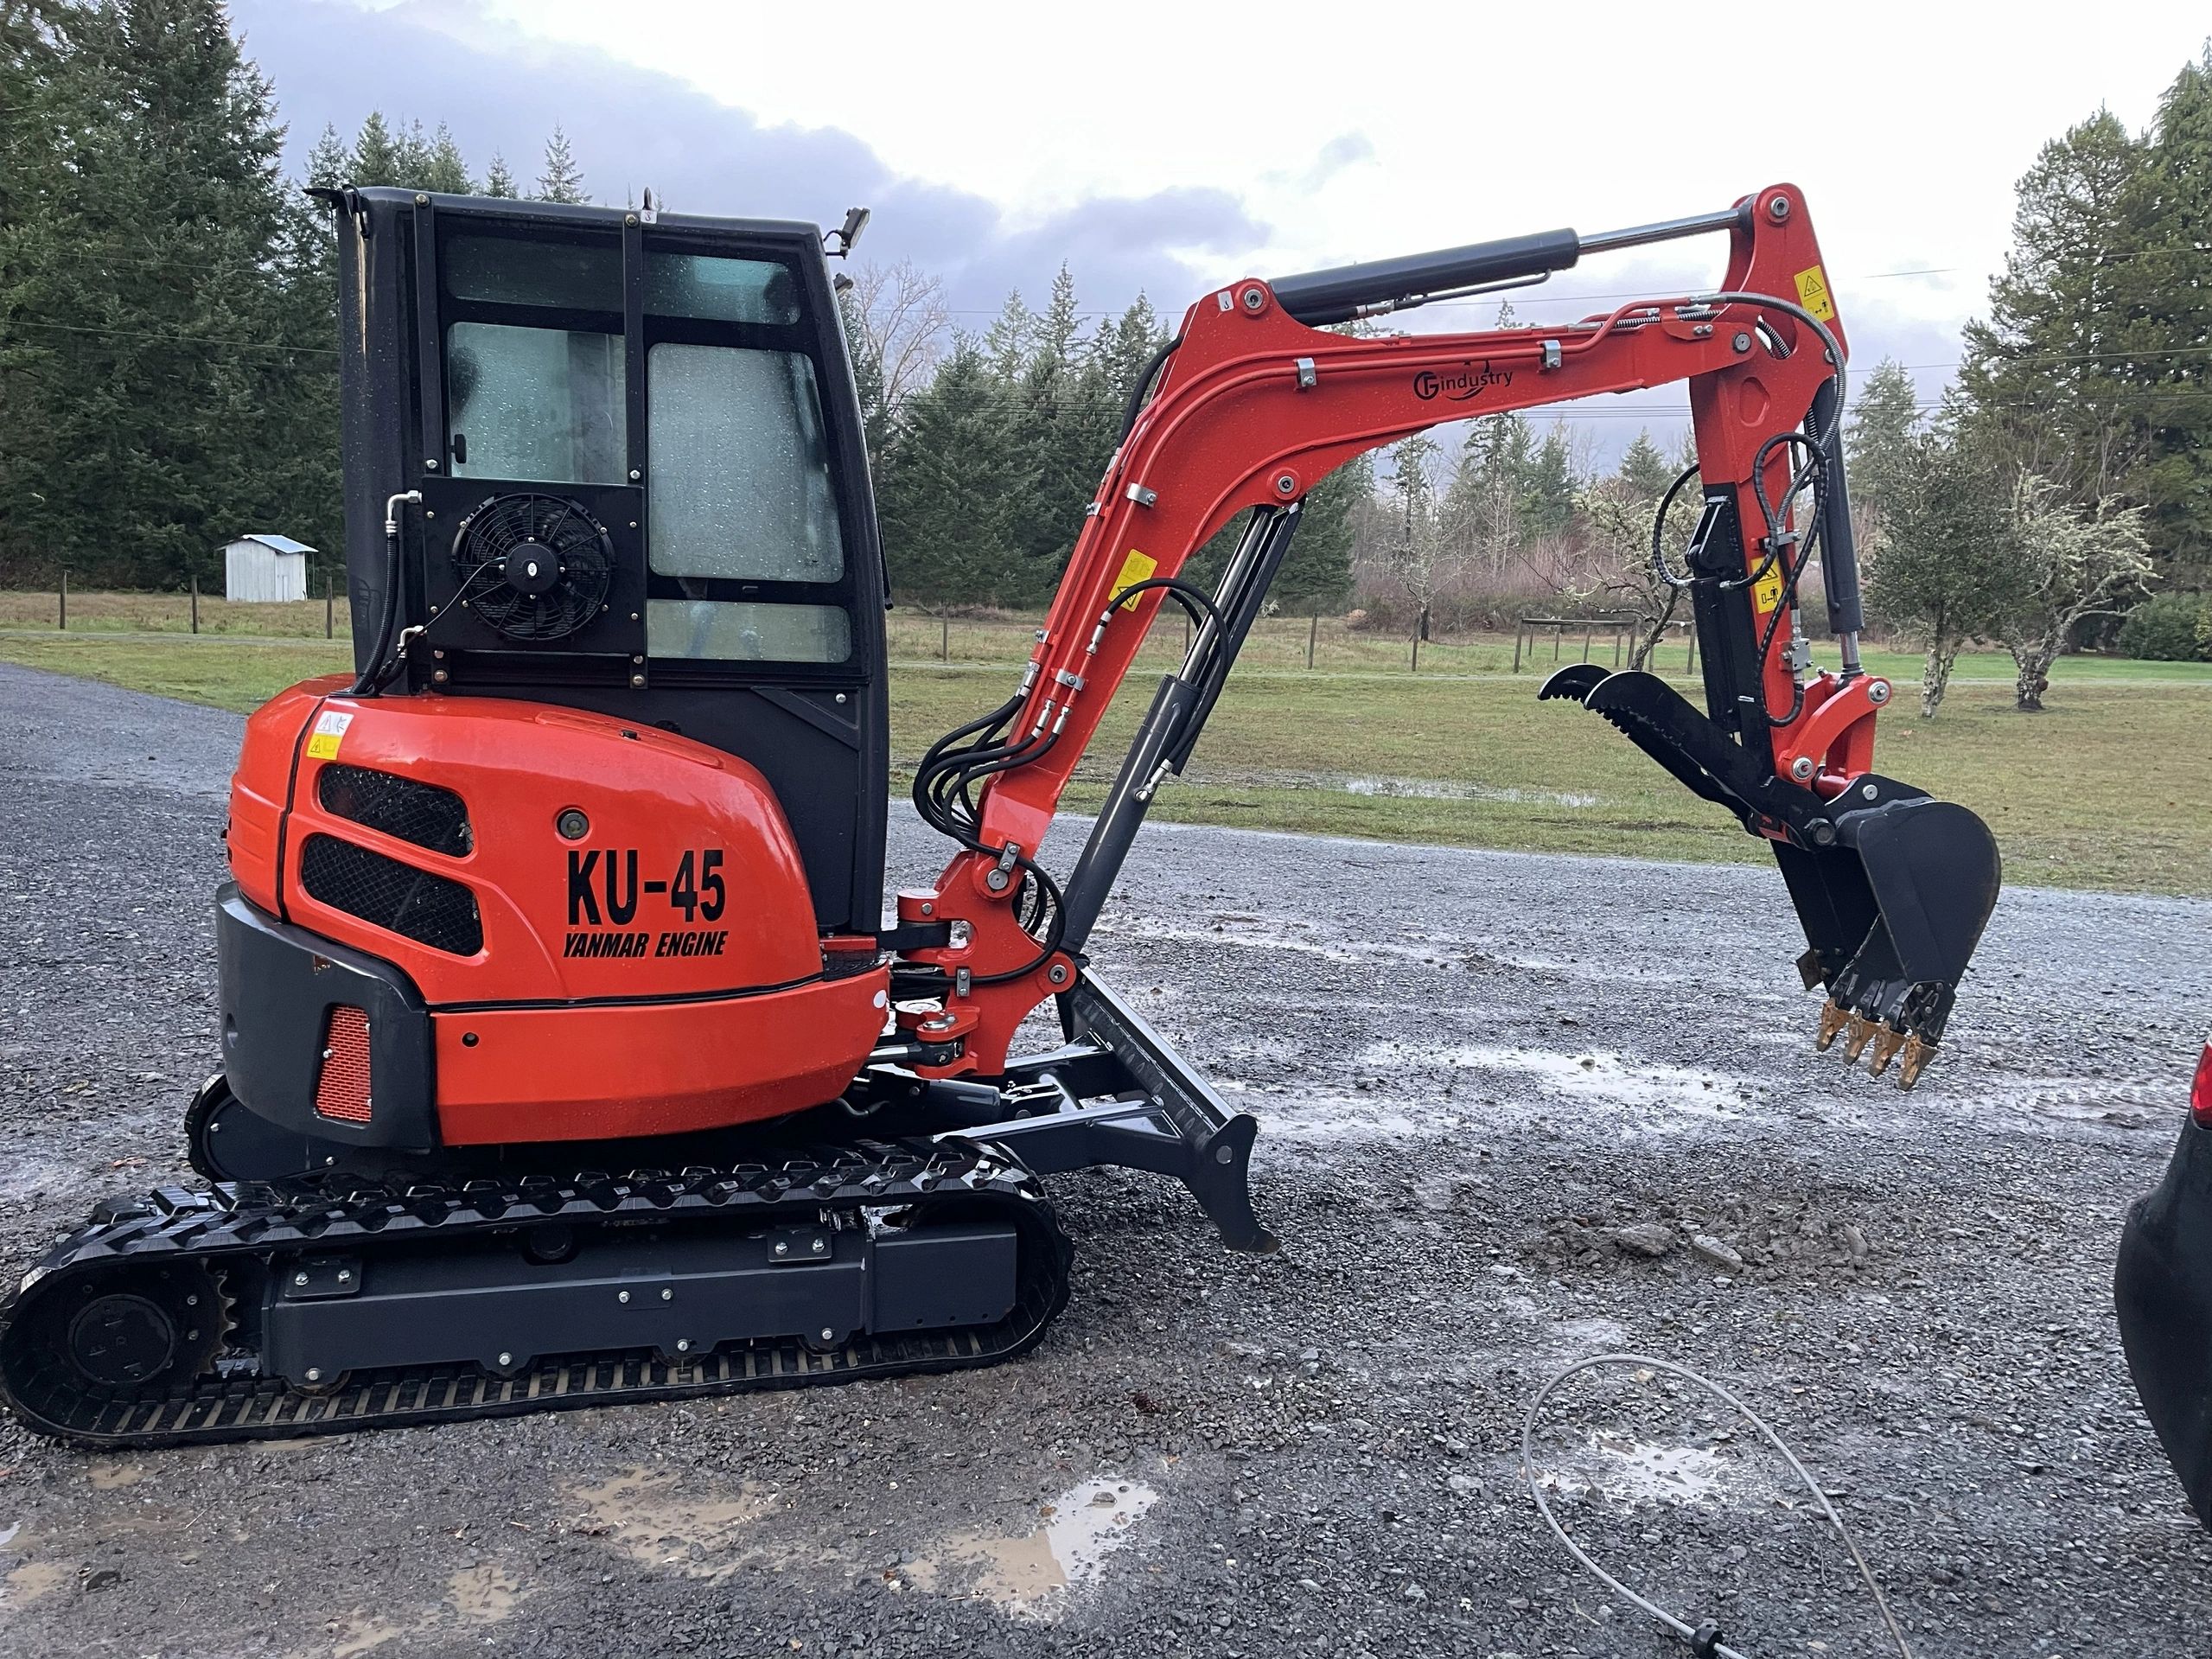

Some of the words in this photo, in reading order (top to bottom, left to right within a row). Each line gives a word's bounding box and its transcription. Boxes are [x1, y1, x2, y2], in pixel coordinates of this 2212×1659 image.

[568, 849, 725, 926] KU-45
[563, 933, 649, 958] YANMAR
[654, 931, 729, 958] ENGINE
